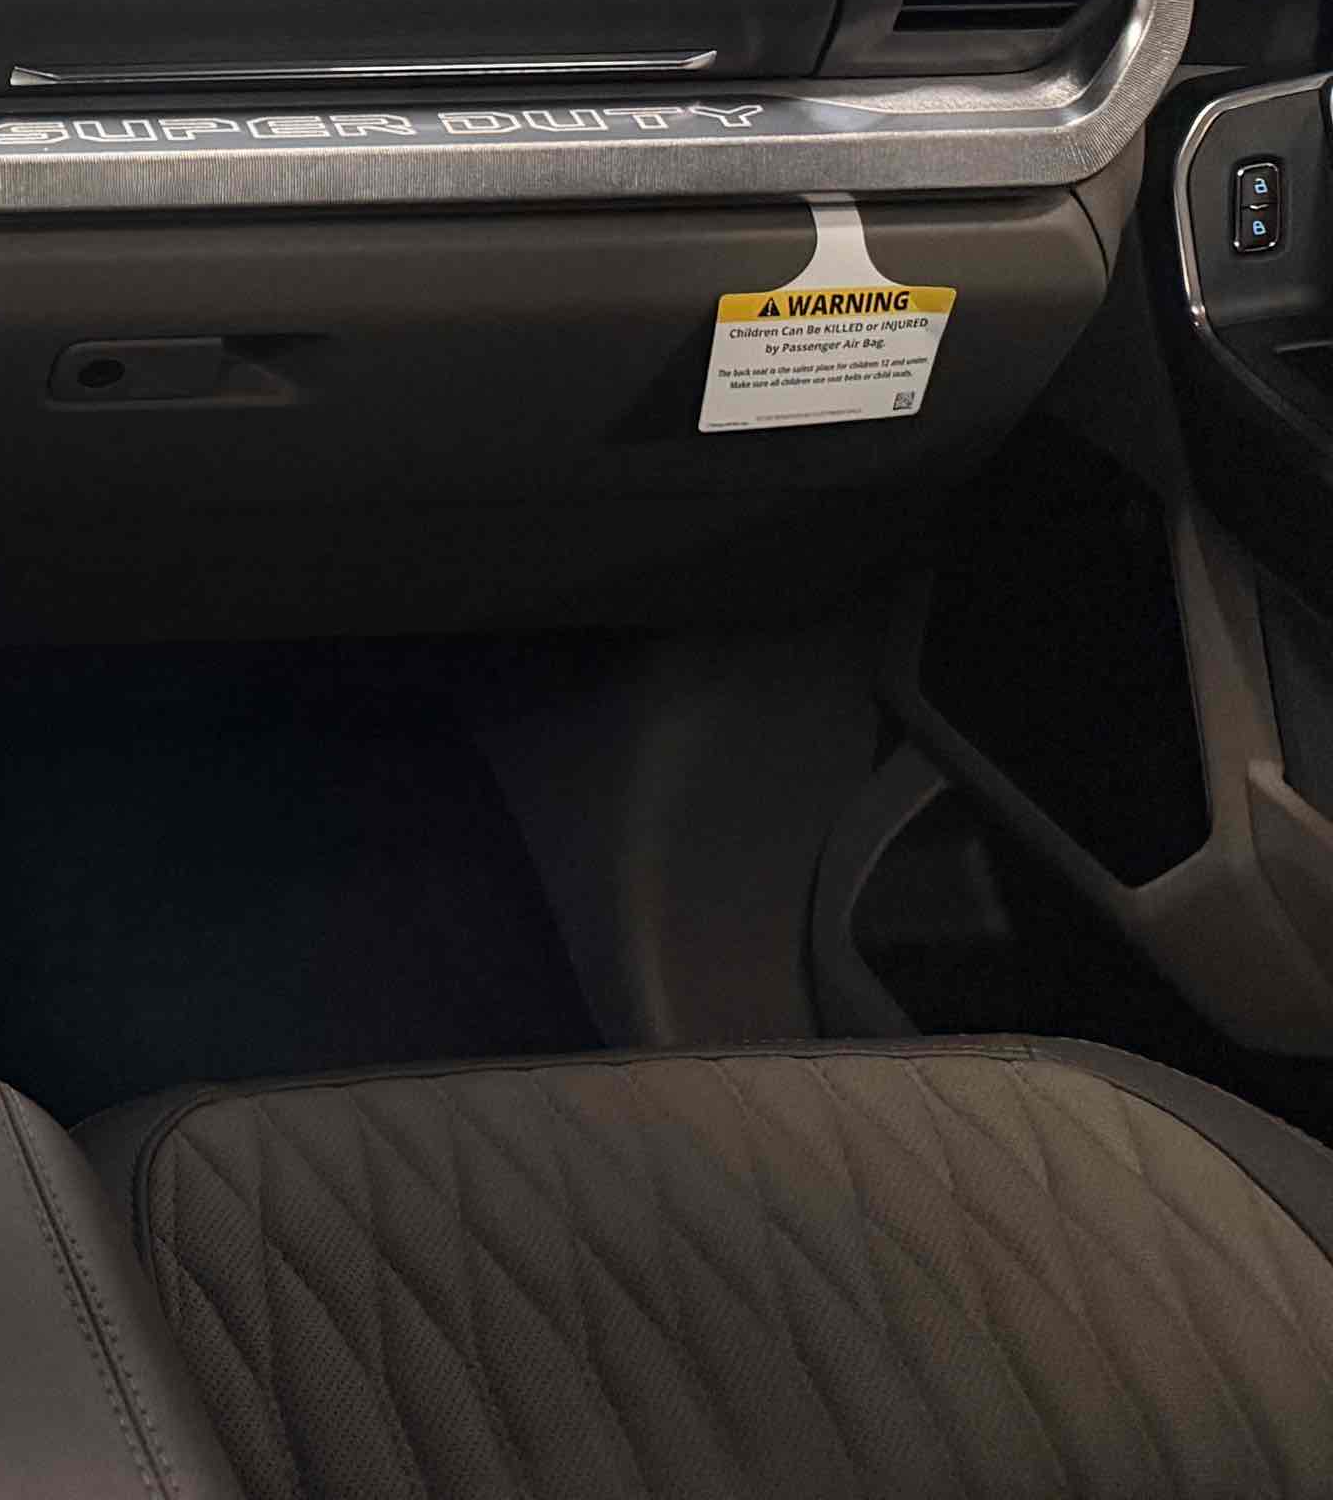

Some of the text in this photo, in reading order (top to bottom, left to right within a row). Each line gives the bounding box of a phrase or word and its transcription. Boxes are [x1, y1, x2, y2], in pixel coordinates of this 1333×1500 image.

[439, 104, 762, 135] DUTY
[788, 291, 910, 317] WARNING
[729, 318, 929, 339] Children Can Be KILLED or INJURED
[765, 344, 779, 356] by
[782, 342, 841, 353] Passenger
[843, 339, 860, 349] Air
[718, 369, 731, 377] The
[733, 368, 750, 377] back
[752, 367, 768, 375] seat
[778, 366, 791, 374] the
[815, 363, 834, 373] place
[849, 360, 880, 369] children
[881, 359, 890, 367] 12
[890, 358, 905, 366] and
[730, 381, 751, 389] Make
[781, 377, 811, 386] children
[827, 375, 843, 383] seat
[873, 371, 891, 380] child
